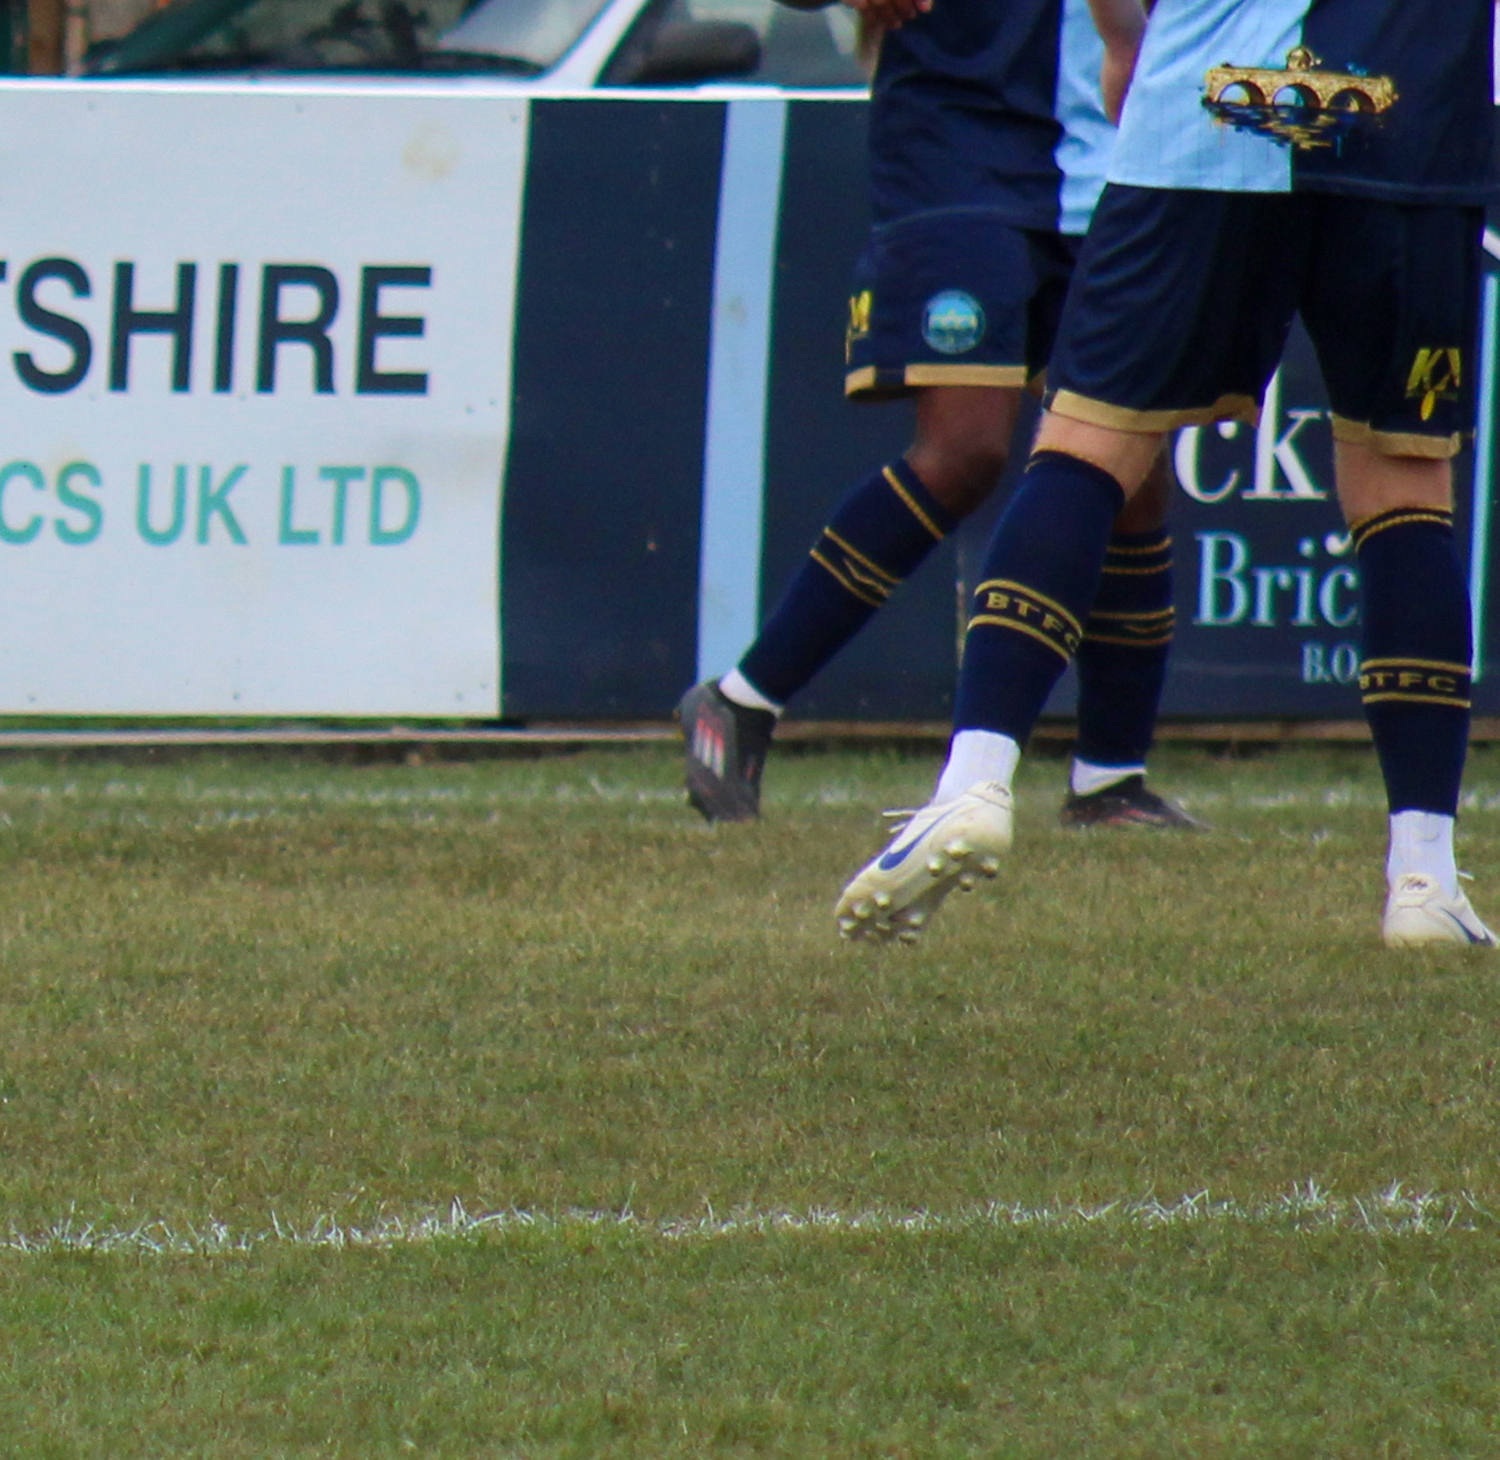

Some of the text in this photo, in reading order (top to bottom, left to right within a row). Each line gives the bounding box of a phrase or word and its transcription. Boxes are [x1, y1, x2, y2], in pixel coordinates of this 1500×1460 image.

[135, 463, 250, 546] UK
[278, 464, 423, 546] LTD
[1192, 531, 1360, 627] Bric
